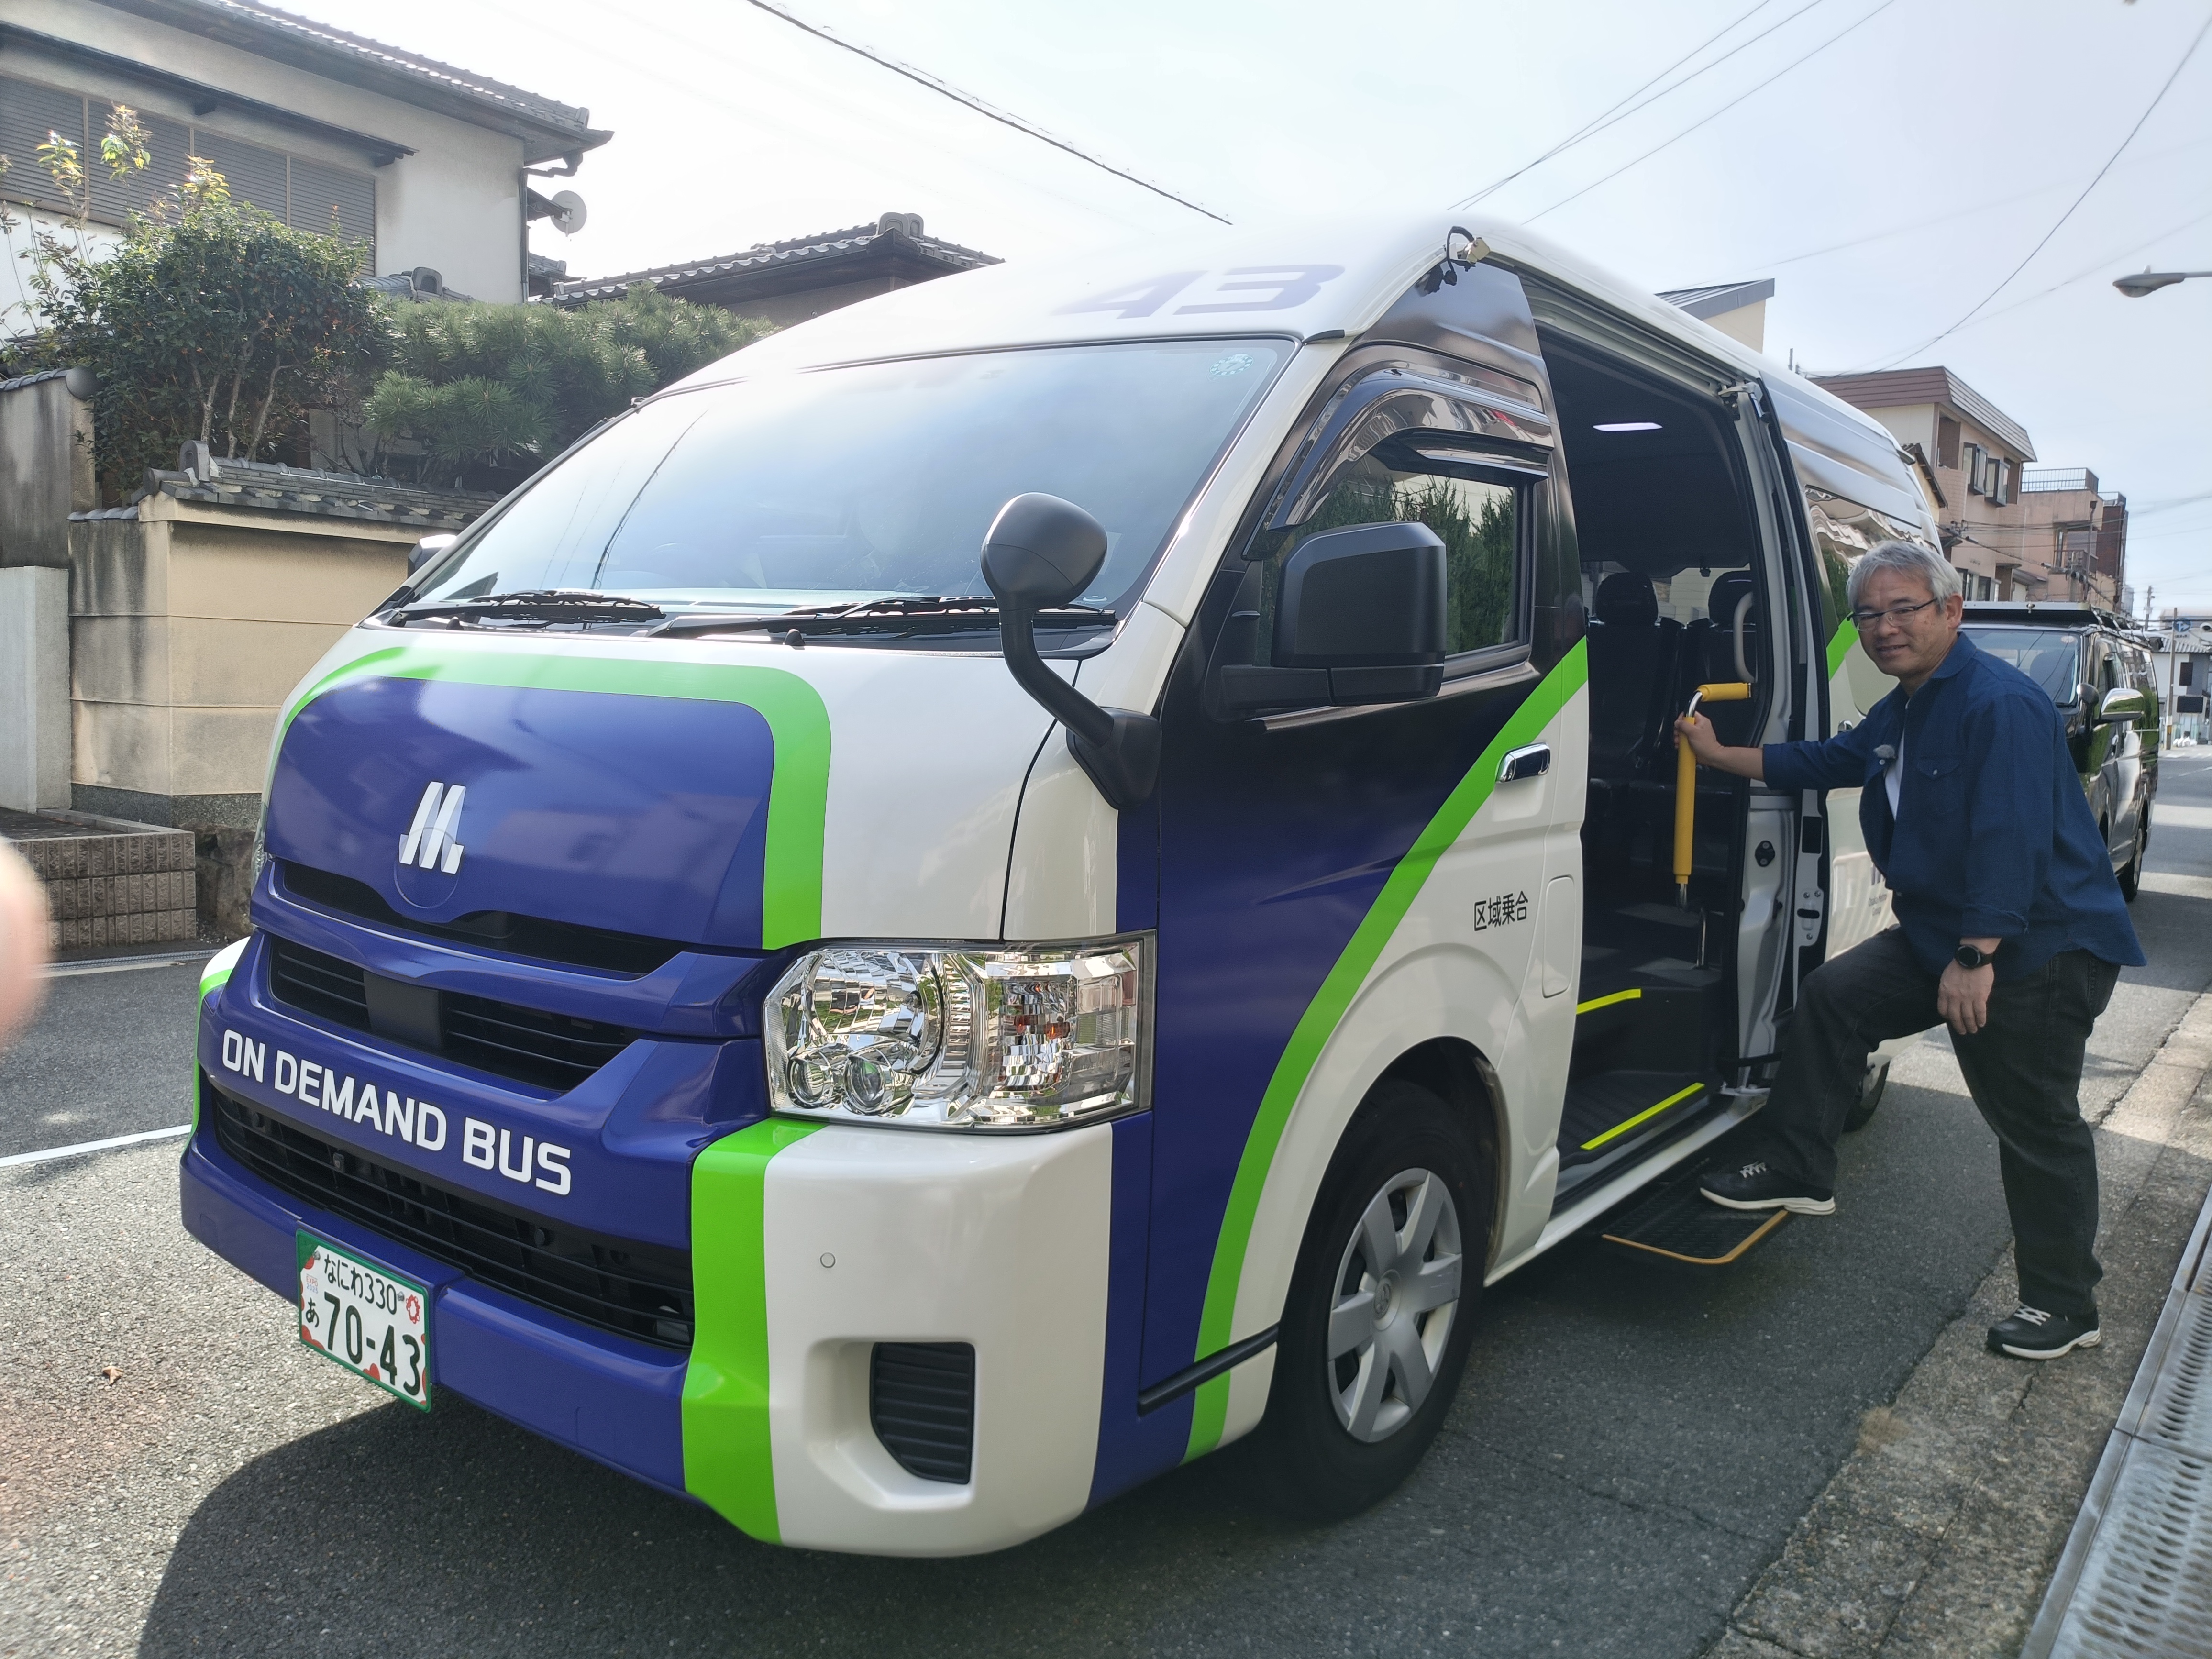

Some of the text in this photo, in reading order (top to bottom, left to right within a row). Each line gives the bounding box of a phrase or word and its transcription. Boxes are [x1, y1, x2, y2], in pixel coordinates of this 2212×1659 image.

[1050, 264, 1346, 320] 43
[1474, 890, 1528, 932] 区域乗合
[222, 1029, 572, 1196] ON DEMAND BUS
[305, 1297, 320, 1328] あ
[324, 1291, 420, 1396] 70-43
